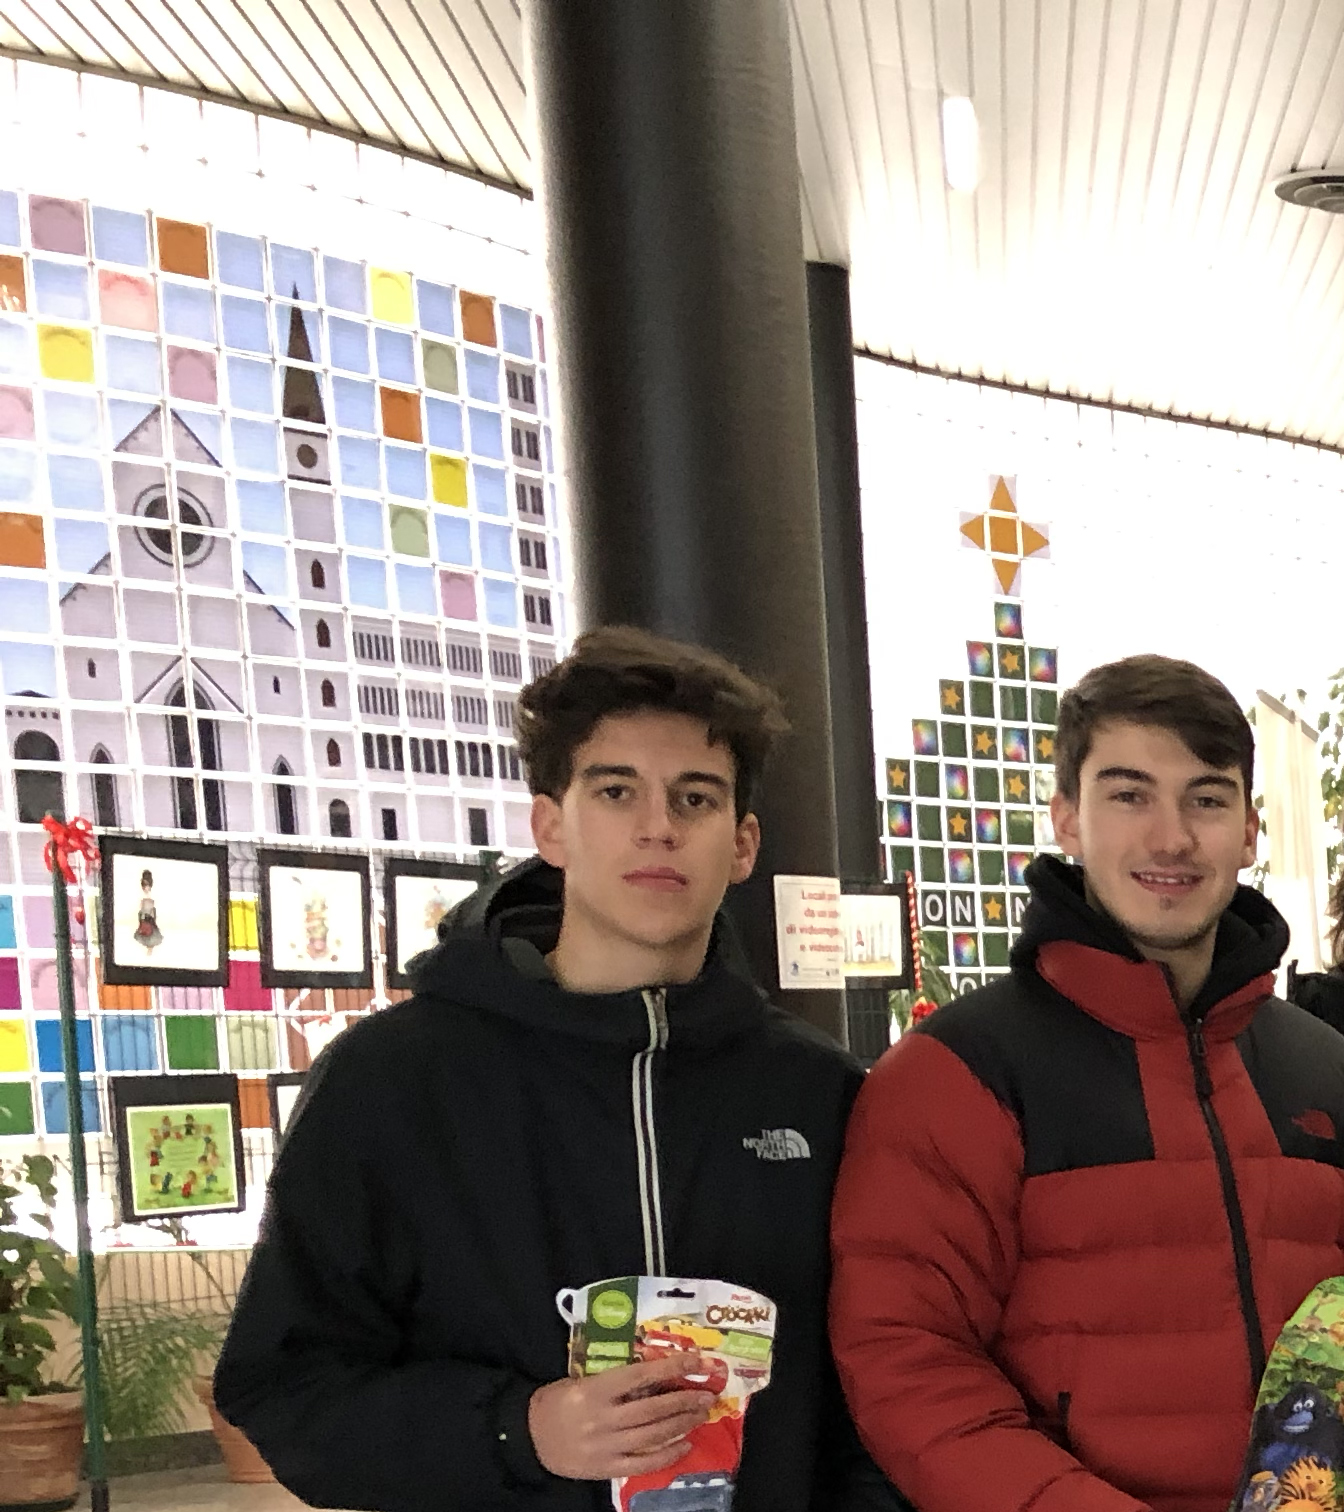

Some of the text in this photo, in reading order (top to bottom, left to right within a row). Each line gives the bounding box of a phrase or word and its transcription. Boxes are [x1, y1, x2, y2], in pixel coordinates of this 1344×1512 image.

[761, 1129, 786, 1141] THE
[743, 1137, 786, 1150] NORTH
[757, 1147, 787, 1161] FACE
